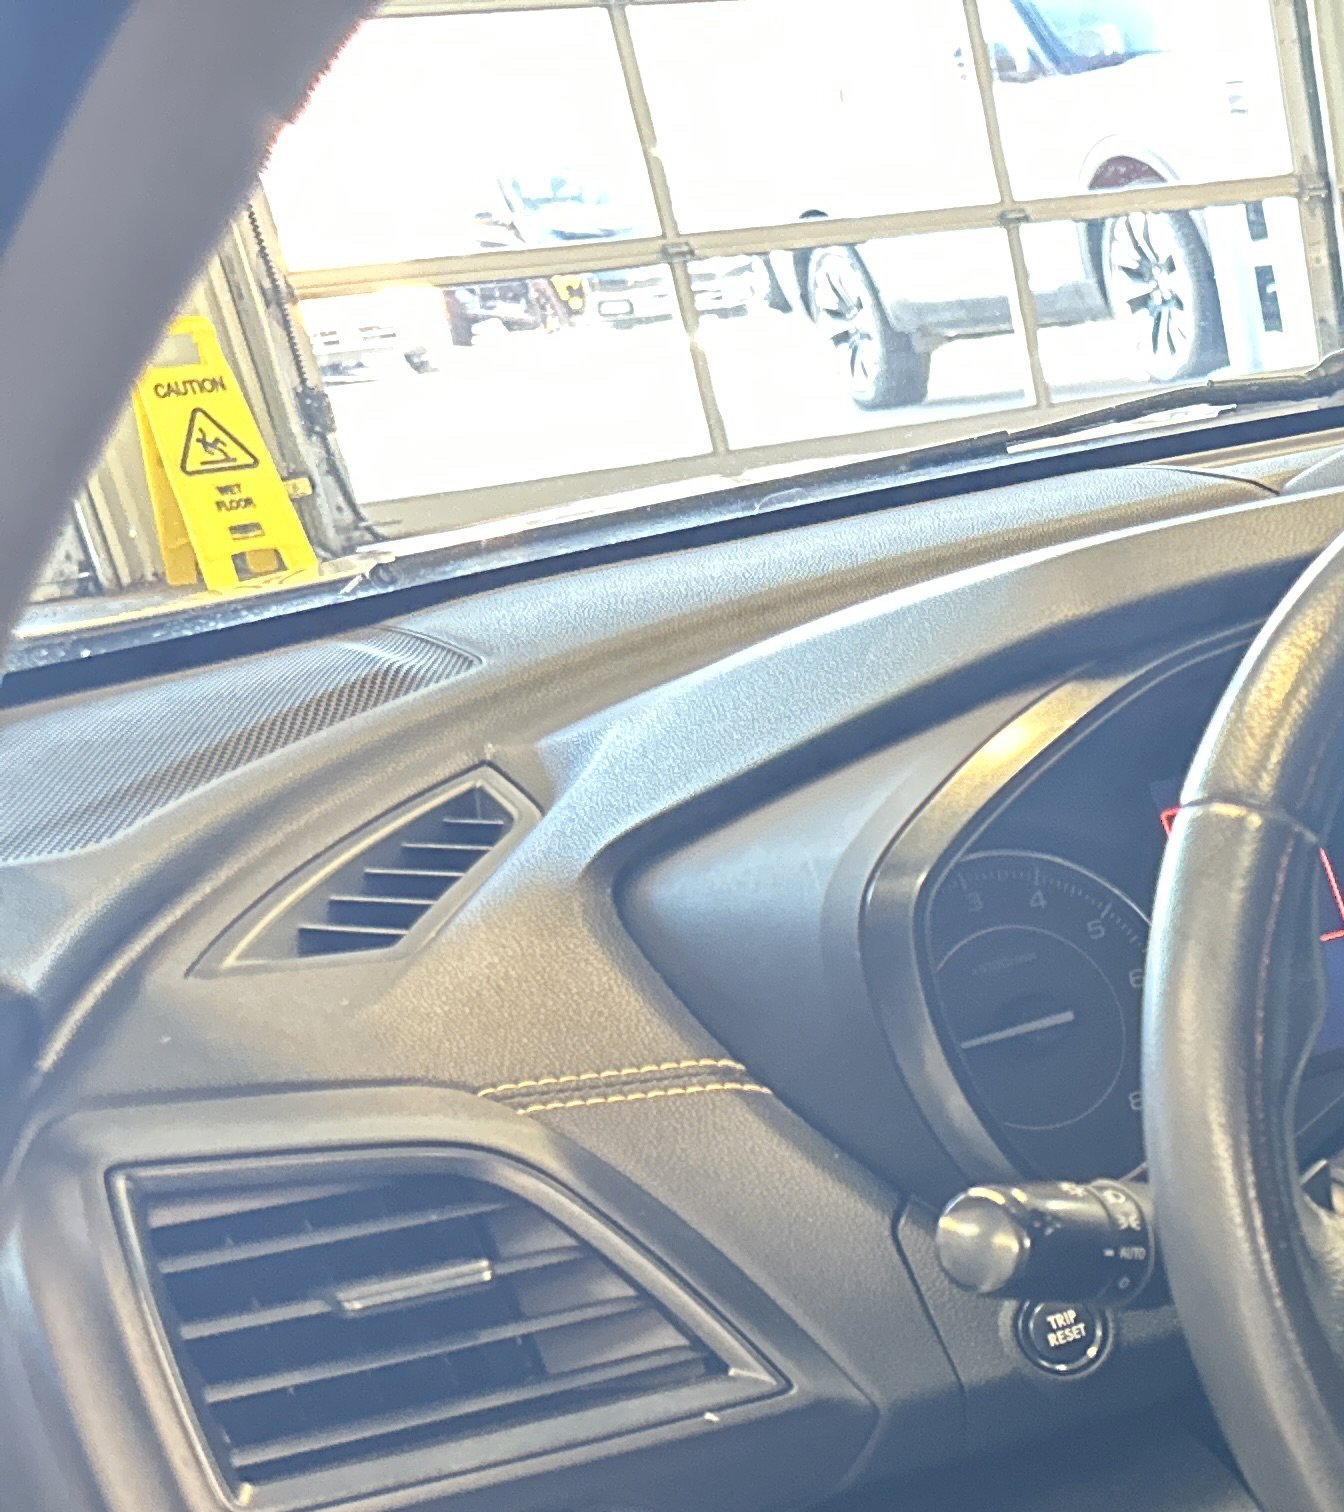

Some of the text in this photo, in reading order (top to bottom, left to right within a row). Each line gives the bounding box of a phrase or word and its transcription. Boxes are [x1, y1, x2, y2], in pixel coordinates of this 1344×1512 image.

[153, 376, 227, 399] CAUTION
[968, 891, 984, 913] 3
[1029, 889, 1048, 911] 4
[1087, 919, 1106, 940] 5
[1119, 1246, 1146, 1260] AUTO
[1046, 1309, 1077, 1330] TRIP
[1047, 1322, 1087, 1347] RESET
